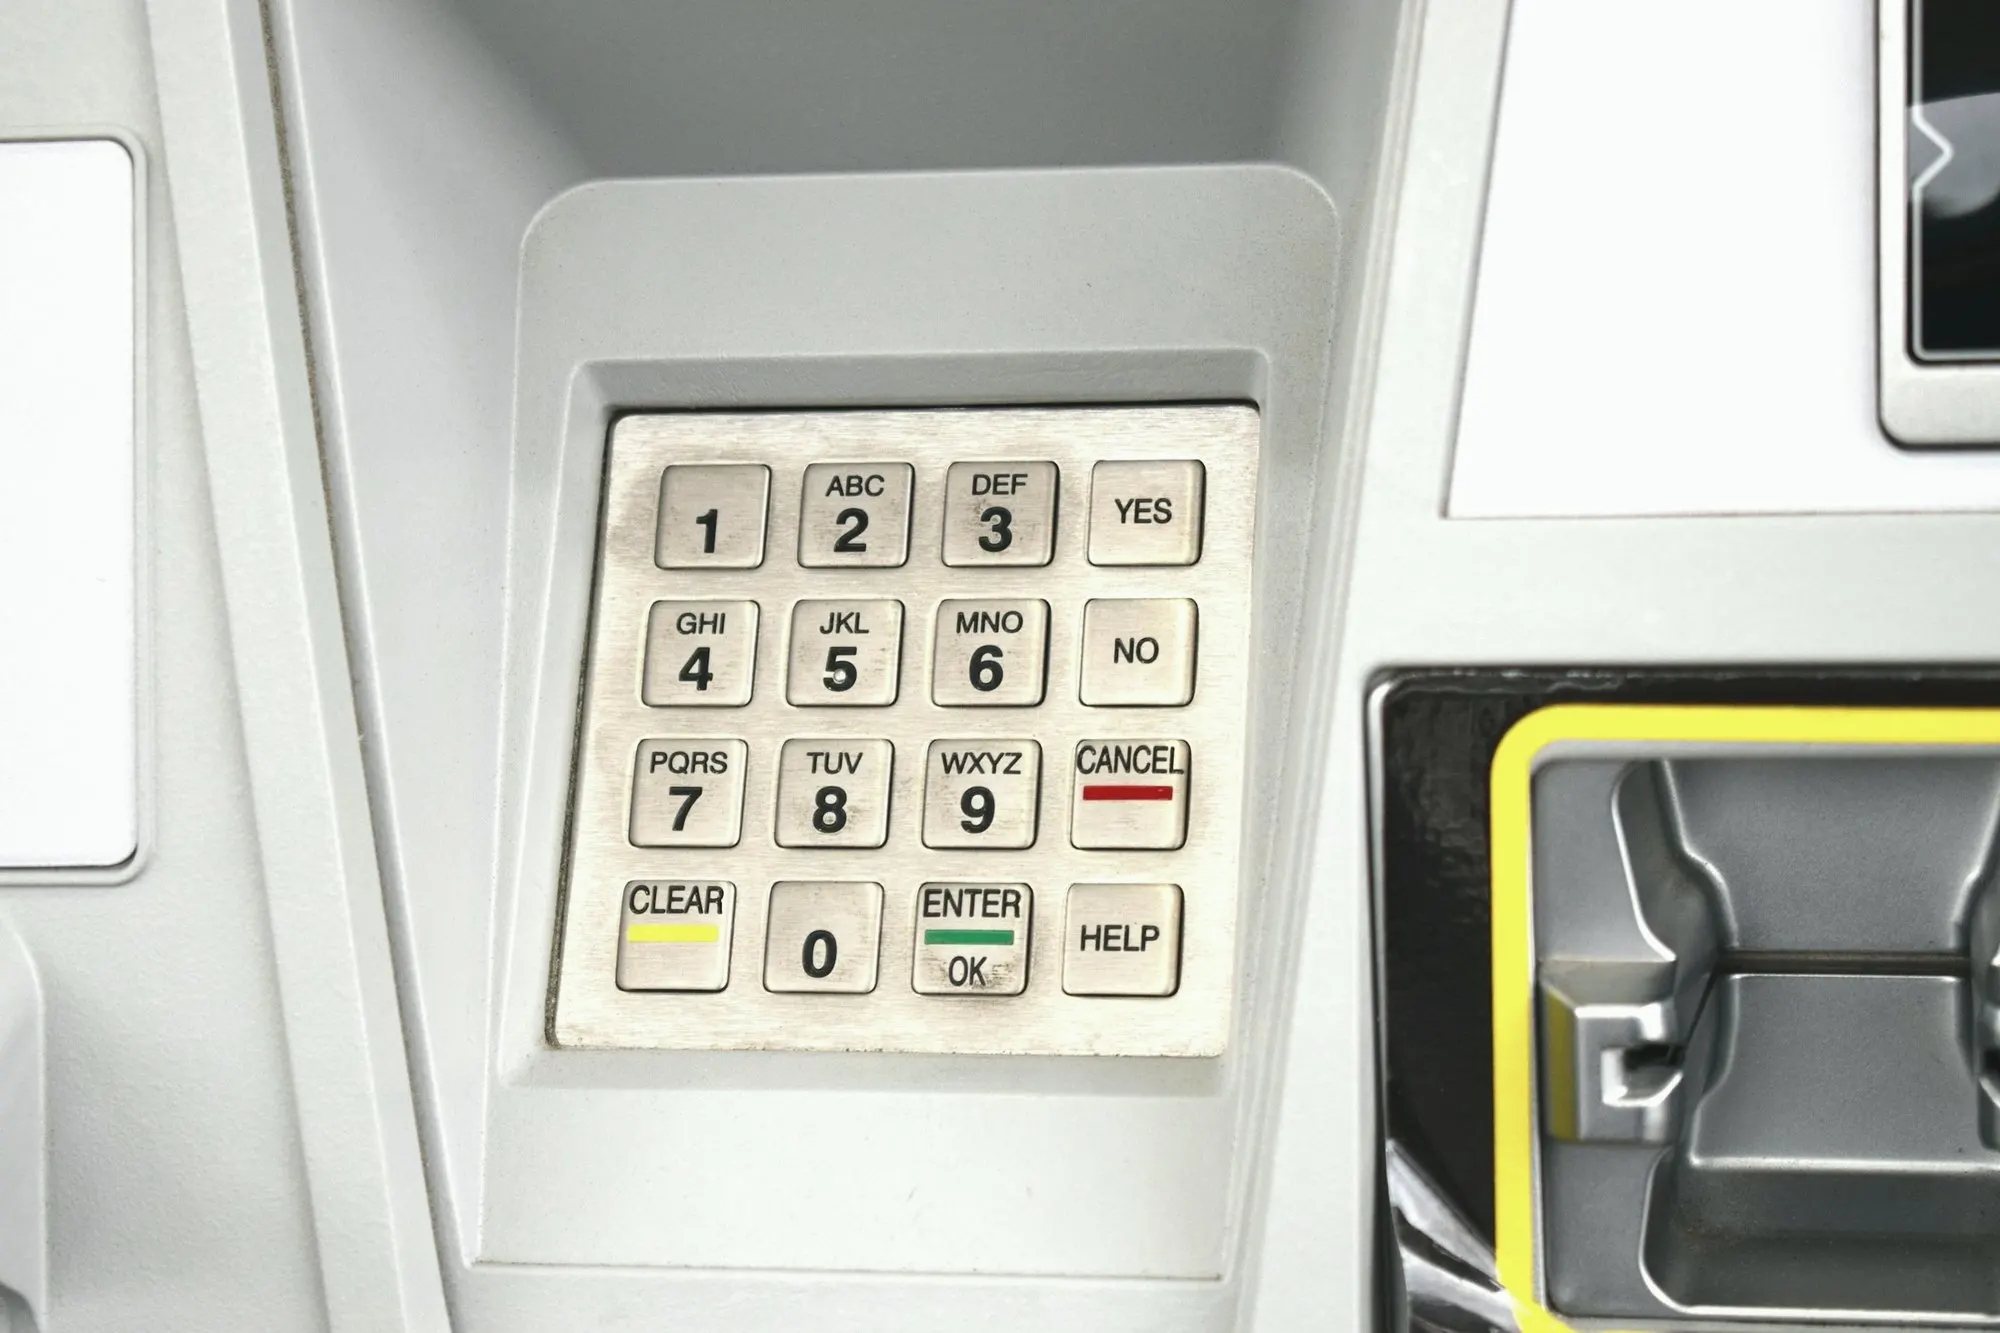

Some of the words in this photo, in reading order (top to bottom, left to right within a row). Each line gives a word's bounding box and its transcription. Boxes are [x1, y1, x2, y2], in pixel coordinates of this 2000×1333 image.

[825, 474, 885, 497] ABC
[971, 473, 1028, 496] DEF
[1114, 497, 1172, 524] YES
[695, 508, 718, 554] 1
[833, 507, 869, 553] 2
[978, 506, 1013, 553] 3
[676, 612, 726, 635] GHI
[819, 612, 870, 635] JKL
[956, 610, 1024, 634] MNO
[1113, 637, 1159, 664] NO
[678, 646, 714, 691] 4
[823, 646, 858, 692] 5
[969, 644, 1004, 692] 6
[650, 751, 728, 775] PQRS
[806, 752, 863, 775] TUV
[941, 751, 1023, 775] WXYZ
[1076, 744, 1185, 775] CANCEL
[669, 786, 703, 832] 7
[812, 785, 847, 834] 8
[960, 786, 996, 834] 9
[629, 884, 725, 915] CLEAR
[923, 888, 1021, 918] ENTER
[1080, 924, 1160, 952] HELP
[802, 929, 838, 979] 0
[948, 955, 987, 987] OK
